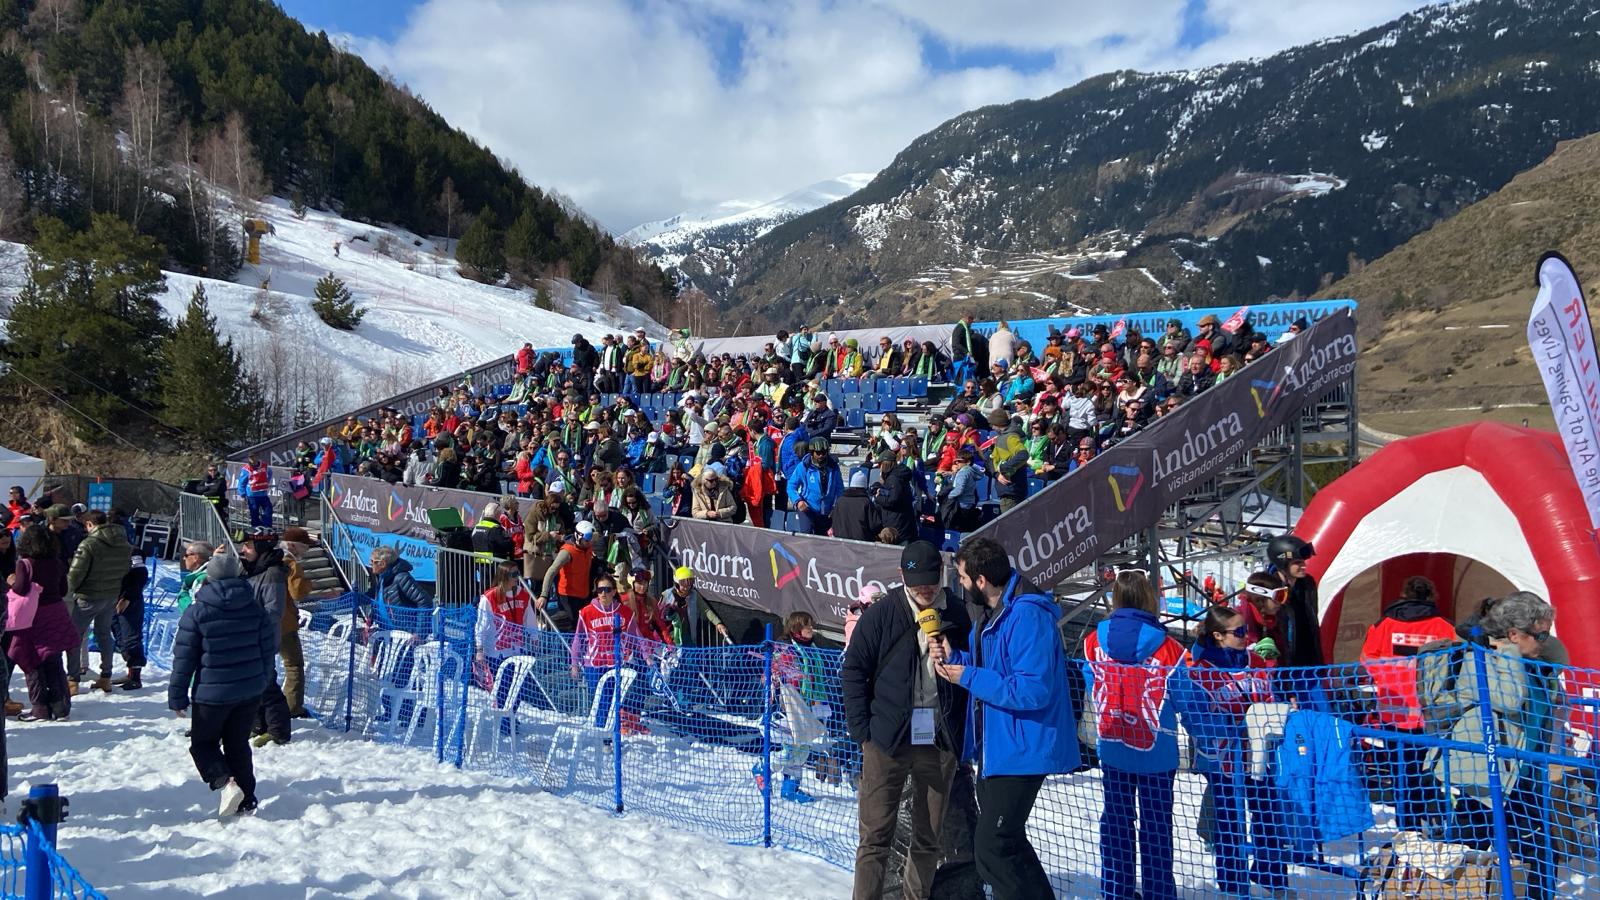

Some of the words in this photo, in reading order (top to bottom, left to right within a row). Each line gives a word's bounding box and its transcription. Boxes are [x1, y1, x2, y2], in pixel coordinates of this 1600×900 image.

[1151, 412, 1243, 489] Andorra
[1168, 439, 1244, 492] visitandorra.com
[1009, 505, 1093, 573] dorra
[1031, 533, 1098, 585] andorra.com
[1486, 725, 1498, 772] LISKI
